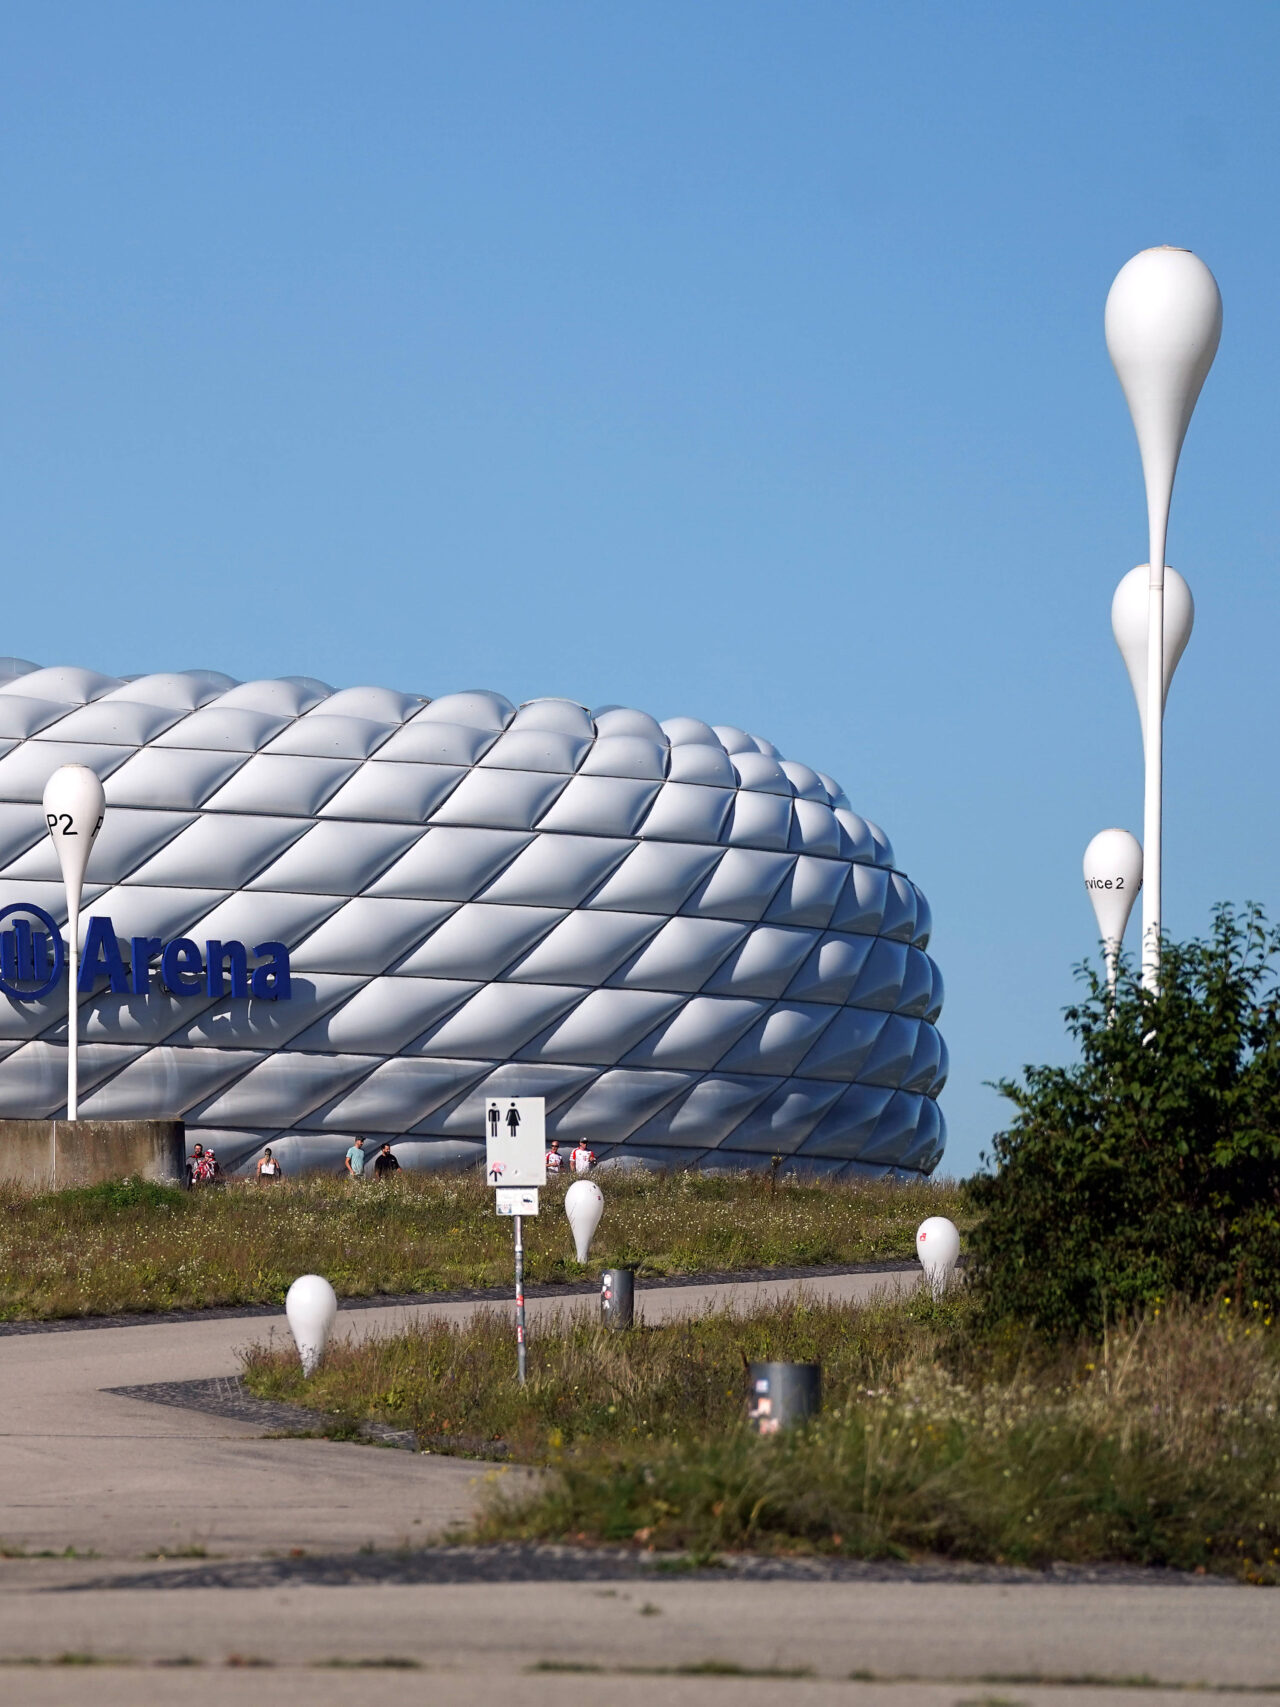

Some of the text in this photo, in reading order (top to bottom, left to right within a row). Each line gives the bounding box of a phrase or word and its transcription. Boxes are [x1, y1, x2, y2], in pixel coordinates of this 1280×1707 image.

[46, 813, 78, 837] P2
[1115, 877, 1124, 889] 2
[76, 915, 291, 1001] Arena
